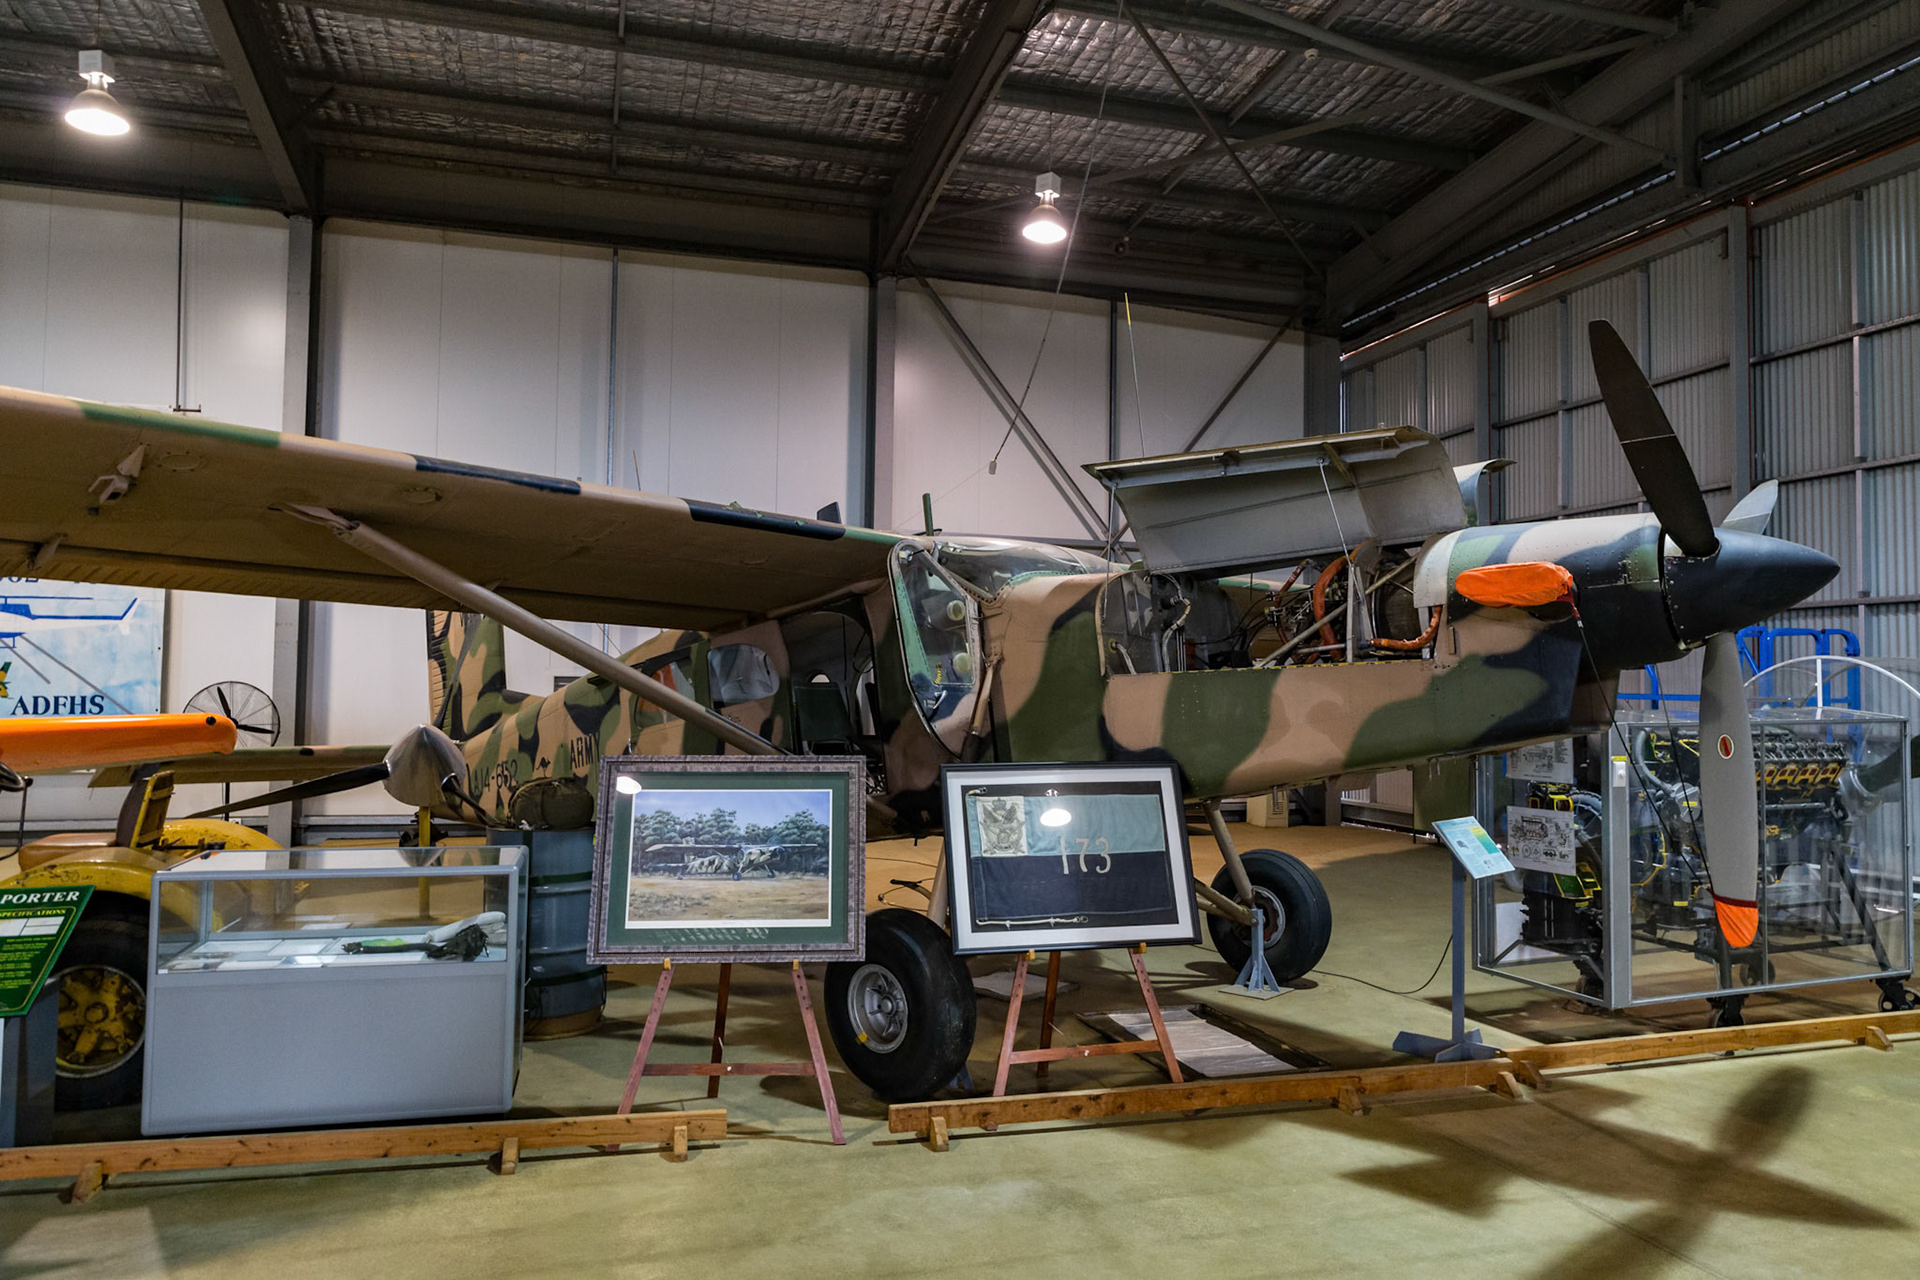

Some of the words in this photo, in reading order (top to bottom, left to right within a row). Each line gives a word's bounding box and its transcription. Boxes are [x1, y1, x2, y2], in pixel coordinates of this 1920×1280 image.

[11, 695, 105, 715] ADFHS
[570, 731, 600, 770] ARMY
[1059, 836, 1112, 875] 173
[0, 891, 80, 904] PORTER
